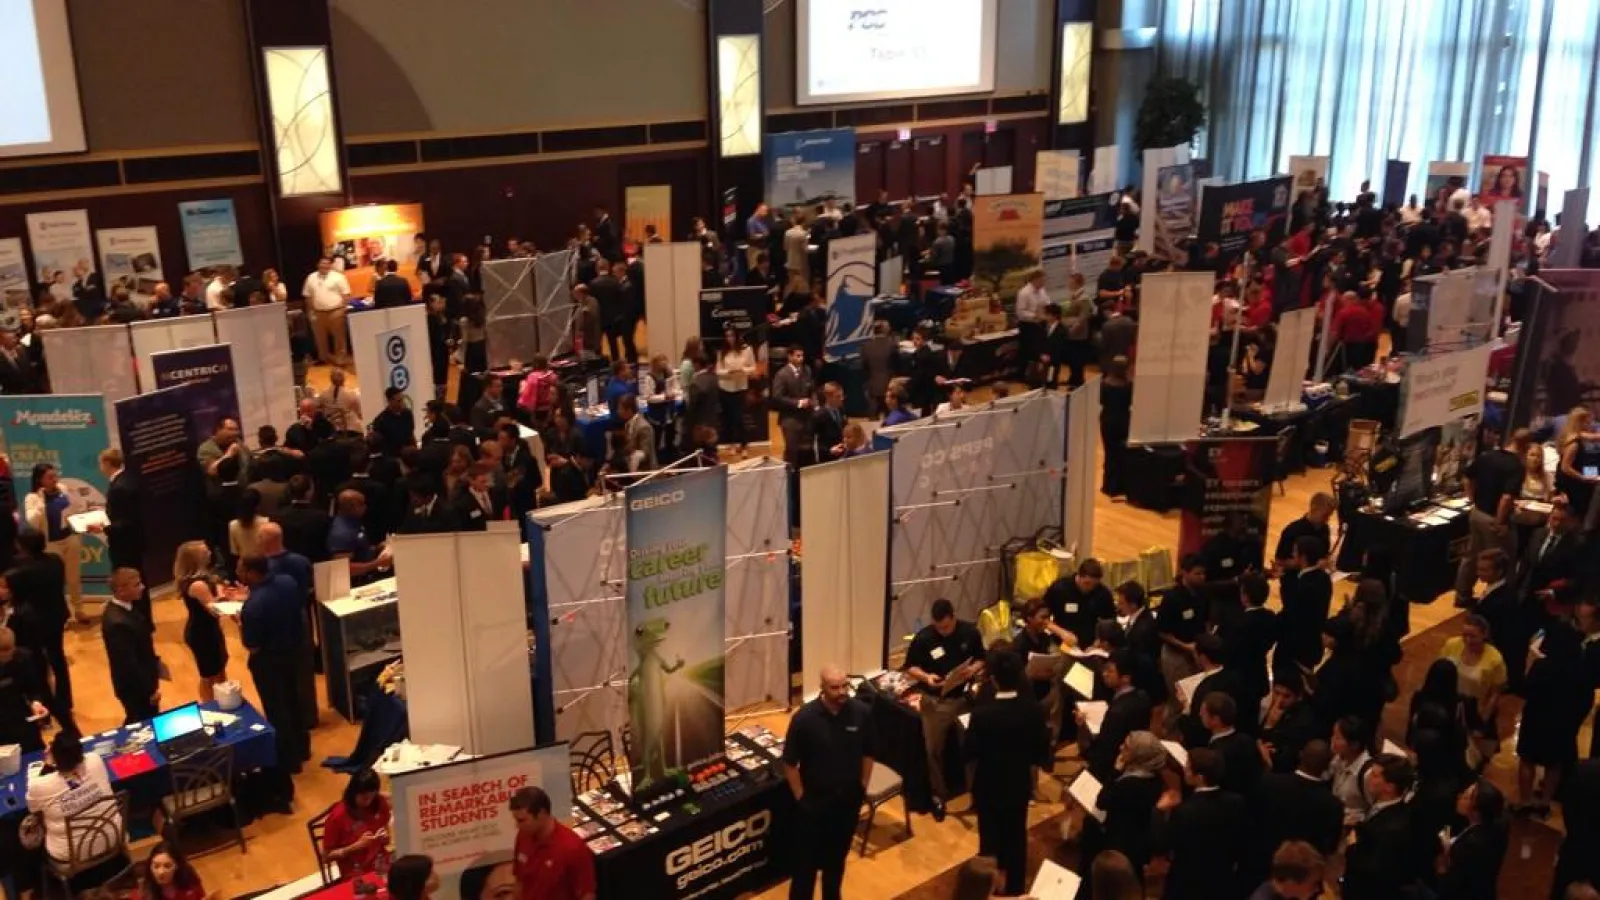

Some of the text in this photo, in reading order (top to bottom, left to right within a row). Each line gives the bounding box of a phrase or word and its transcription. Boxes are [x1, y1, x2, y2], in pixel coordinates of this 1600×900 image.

[630, 489, 684, 511] GEICO
[630, 543, 708, 581] career
[644, 566, 723, 611] future
[418, 774, 529, 806] IN SEARCH OF
[420, 789, 519, 819] REMARKABL
[420, 805, 499, 832] STUDENTS
[666, 809, 771, 876] GEICO
